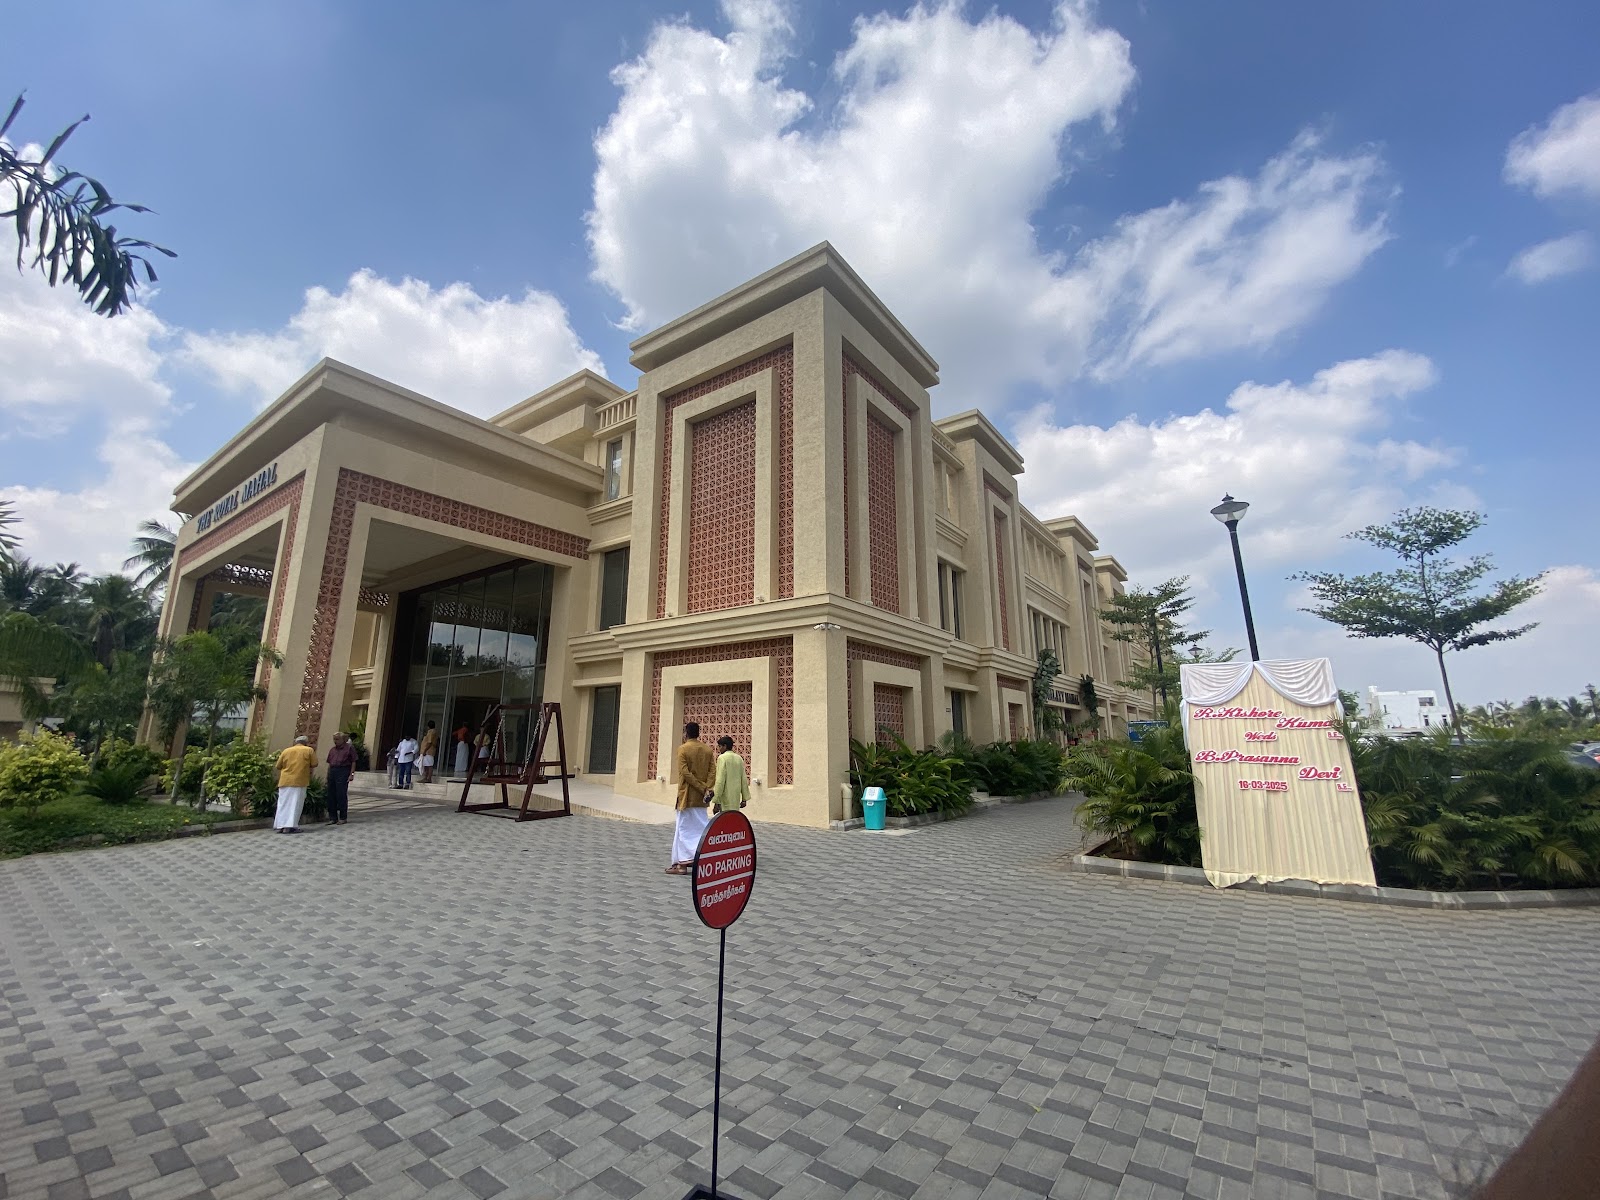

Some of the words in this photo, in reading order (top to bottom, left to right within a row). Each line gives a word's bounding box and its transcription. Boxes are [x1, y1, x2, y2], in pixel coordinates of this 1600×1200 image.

[1276, 717, 1342, 729] Kuma
[1244, 731, 1277, 741] Weds
[1298, 766, 1341, 779] Devi
[1238, 780, 1288, 791] 16-03-2025
[698, 863, 713, 879] NO
[715, 854, 752, 874] PARKING
